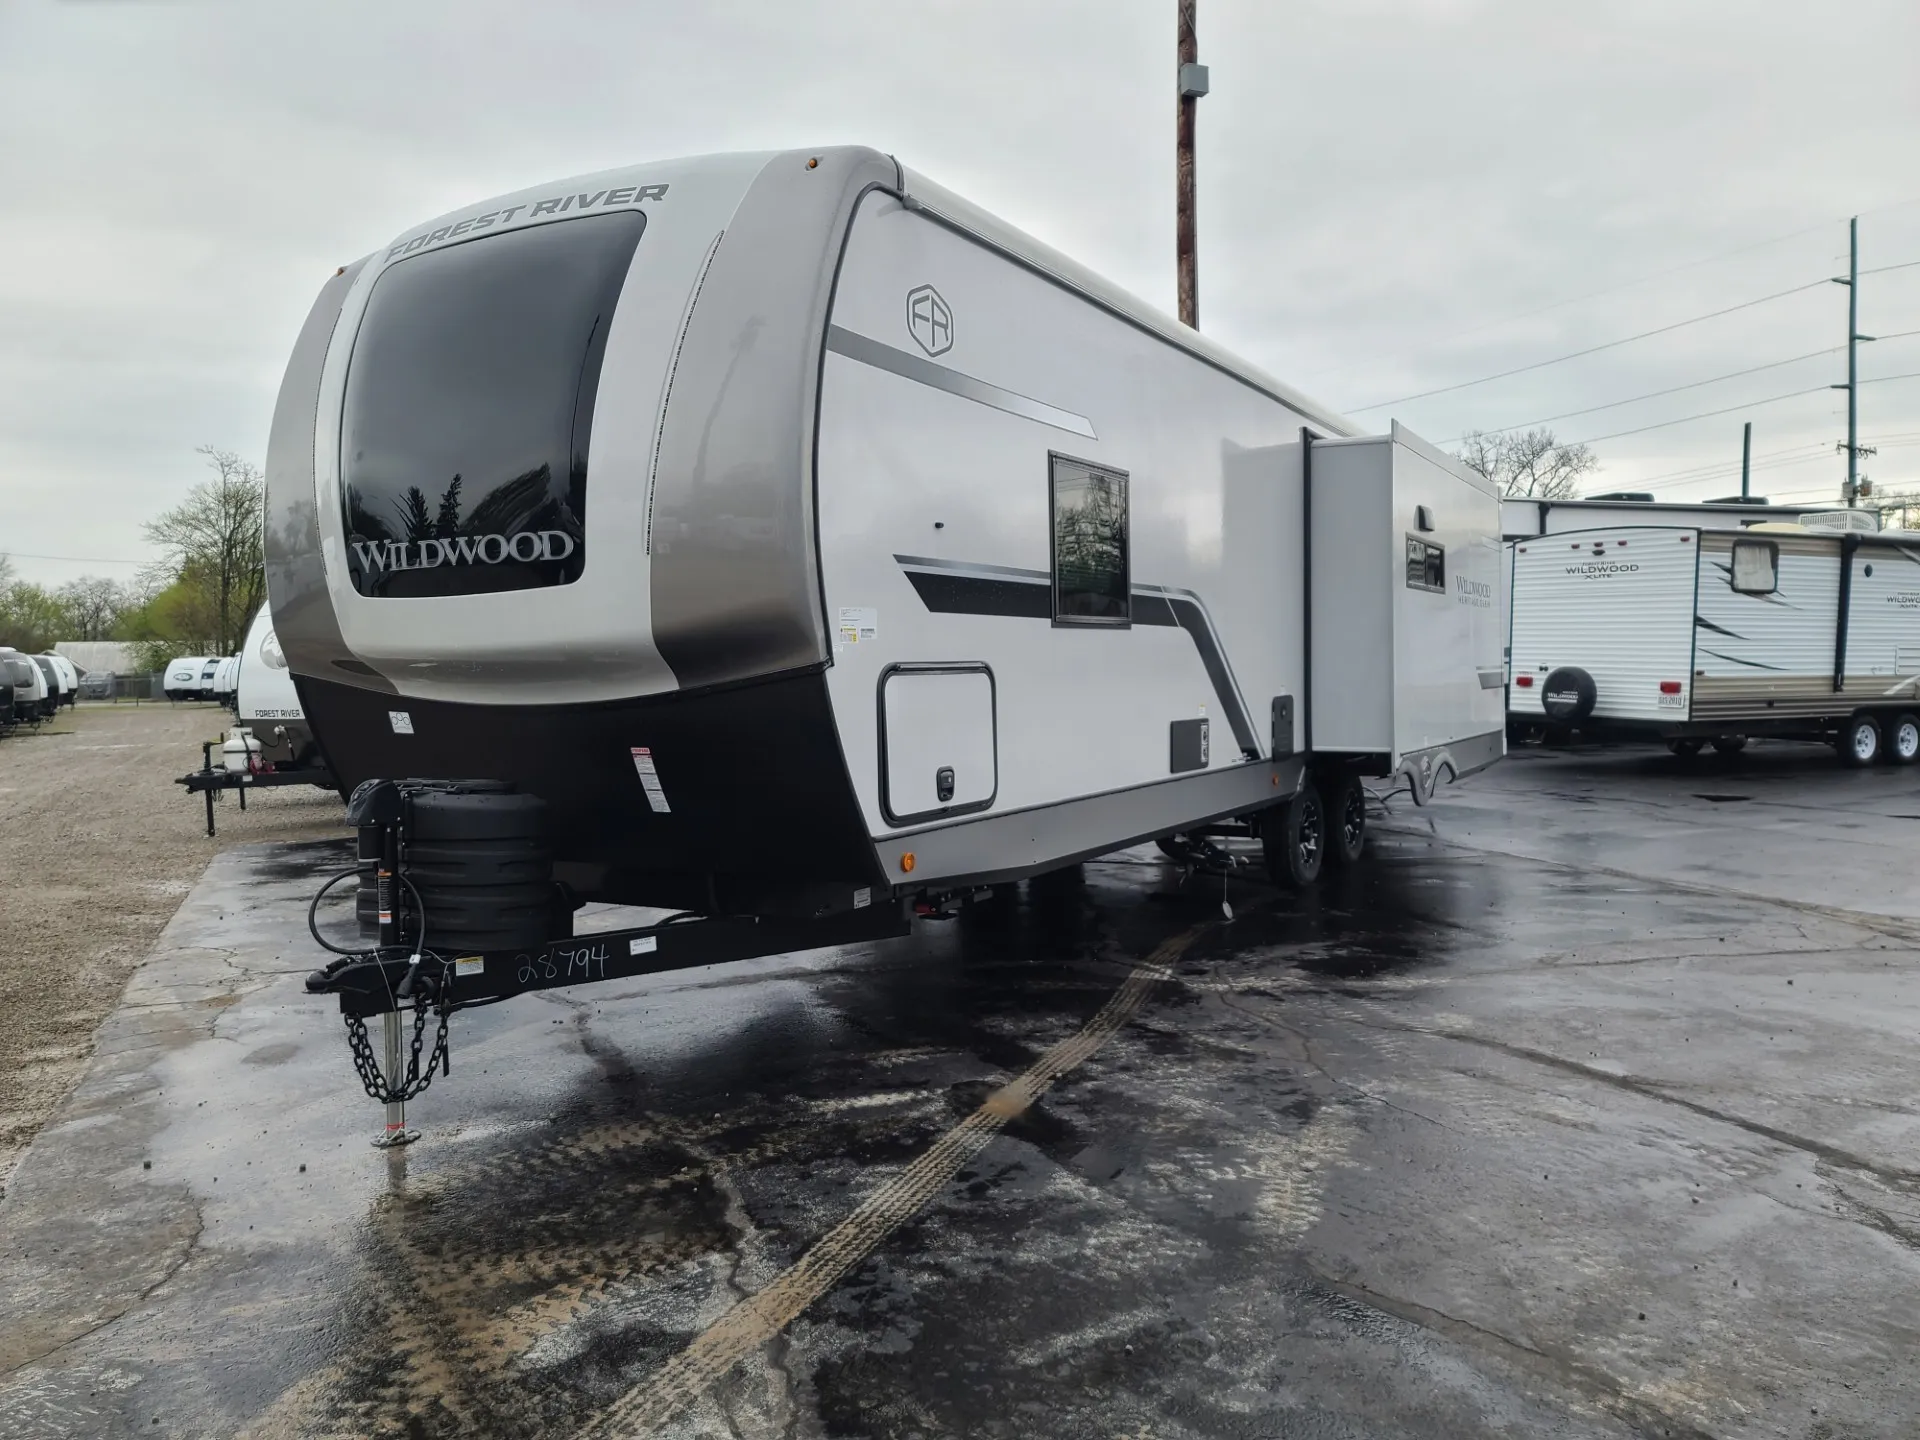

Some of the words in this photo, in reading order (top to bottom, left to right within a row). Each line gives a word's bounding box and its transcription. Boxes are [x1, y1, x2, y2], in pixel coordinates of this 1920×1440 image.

[383, 204, 527, 264] FOREST
[530, 183, 670, 218] RIVER
[352, 530, 574, 574] WILDWOOD
[1565, 564, 1640, 574] WILDWOOD
[1455, 575, 1491, 598] WILDWOOD
[255, 709, 279, 718] FOREST
[280, 709, 300, 718] RIVER
[515, 943, 610, 983] 28794
